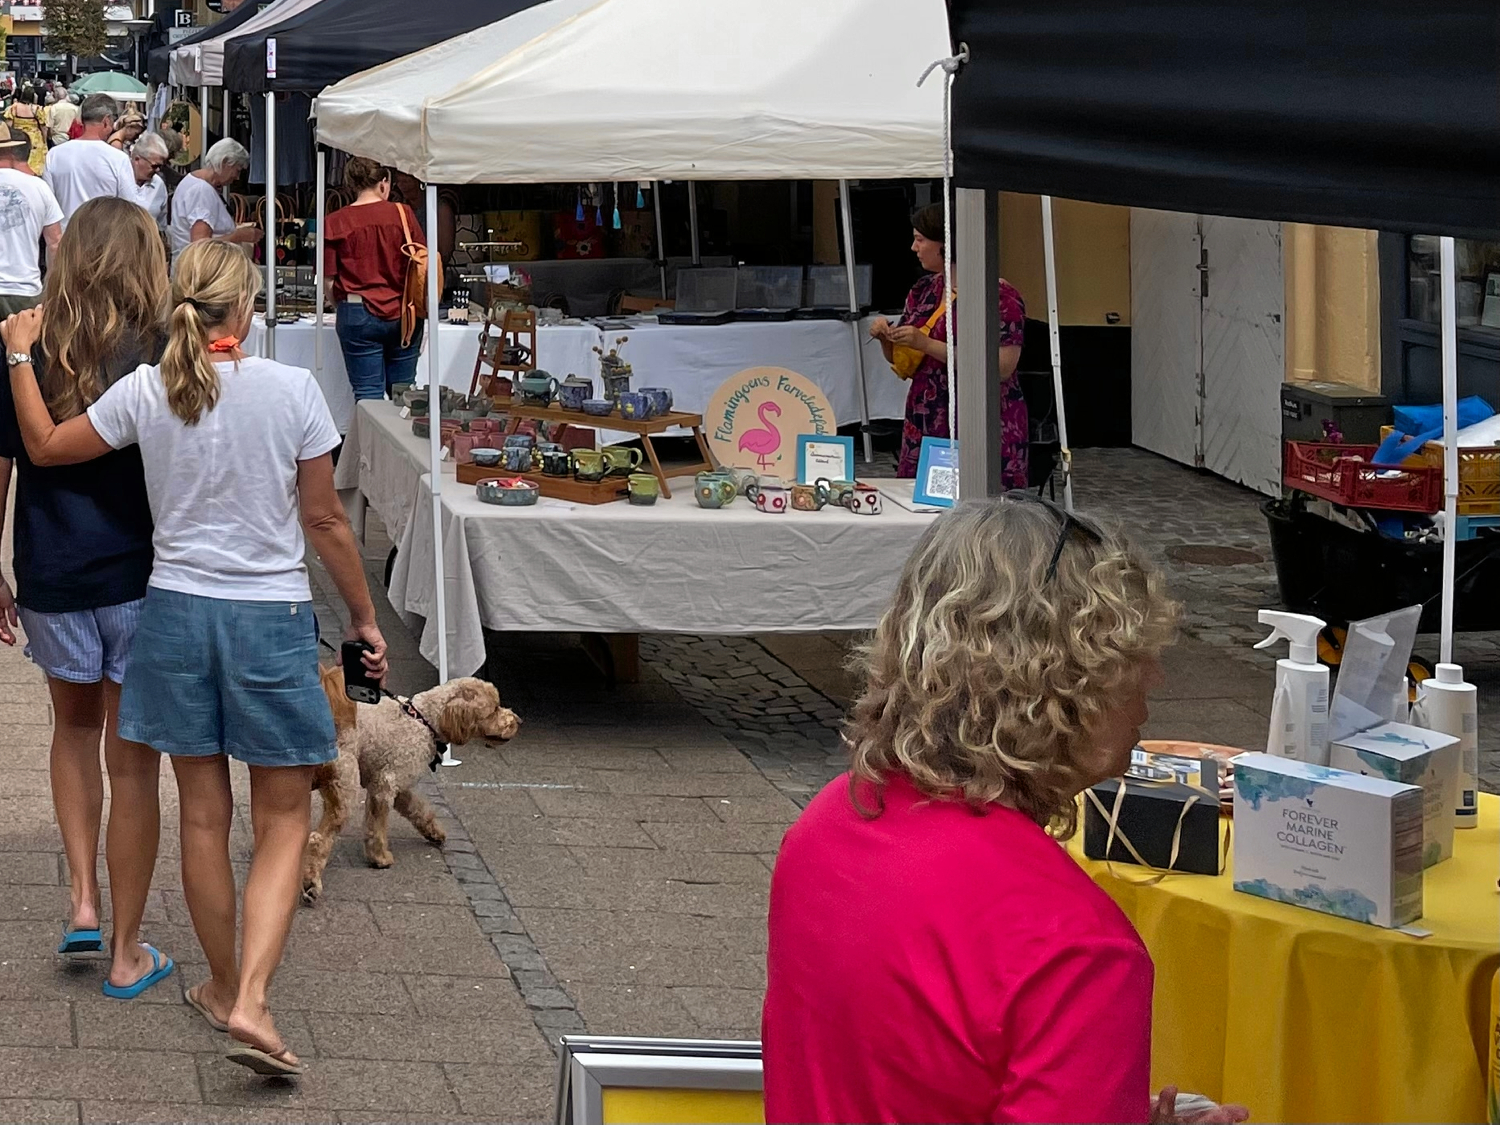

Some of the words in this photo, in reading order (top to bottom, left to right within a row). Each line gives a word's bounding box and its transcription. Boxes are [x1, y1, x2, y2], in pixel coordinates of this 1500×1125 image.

[714, 375, 770, 443] Flamingoens
[776, 374, 829, 436] Farveladefab
[1282, 808, 1339, 831] FOREVER
[1286, 821, 1334, 841] MARINE
[1276, 831, 1345, 855] COLLAGEN
